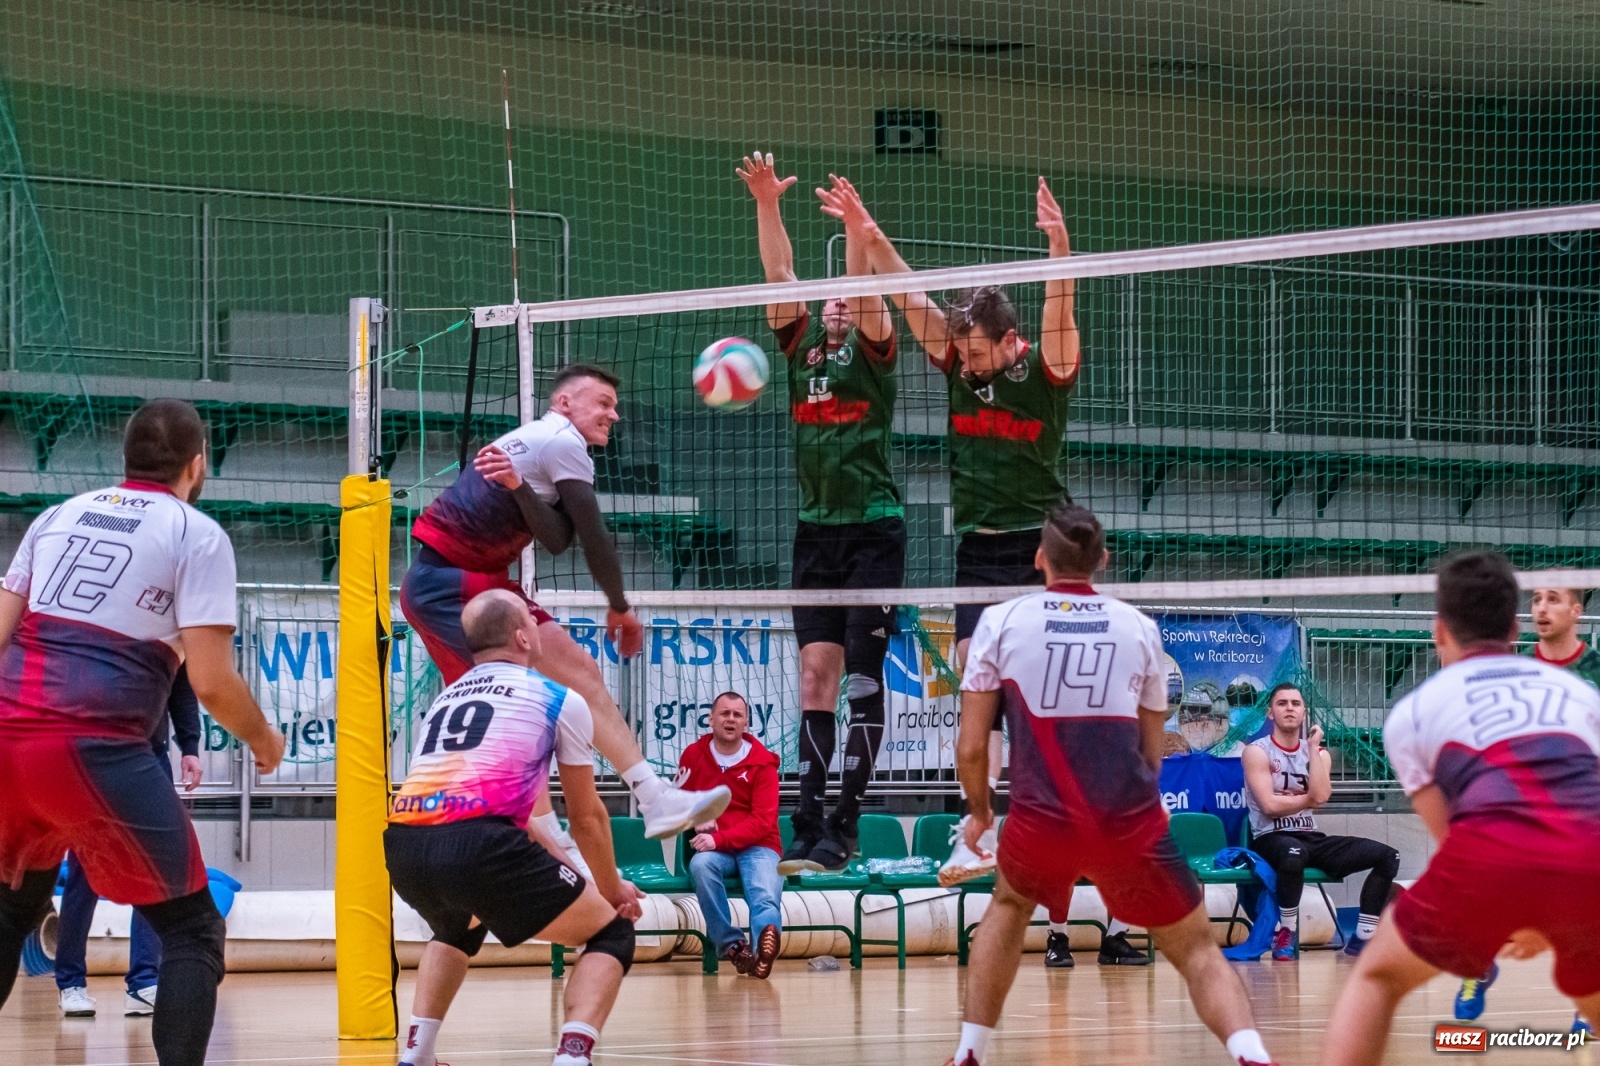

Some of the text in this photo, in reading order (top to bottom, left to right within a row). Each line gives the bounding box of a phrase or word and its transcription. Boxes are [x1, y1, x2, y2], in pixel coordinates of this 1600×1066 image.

[886, 127, 924, 148] D
[37, 535, 132, 614] 12
[1162, 628, 1201, 644] Sportu
[1209, 630, 1266, 647] Rekreacji
[1208, 649, 1264, 664] Raciborzu
[1040, 642, 1116, 709] 14
[1465, 680, 1570, 746] 37
[420, 700, 495, 756] 19
[886, 740, 927, 752] oaza
[558, 864, 577, 888] 19
